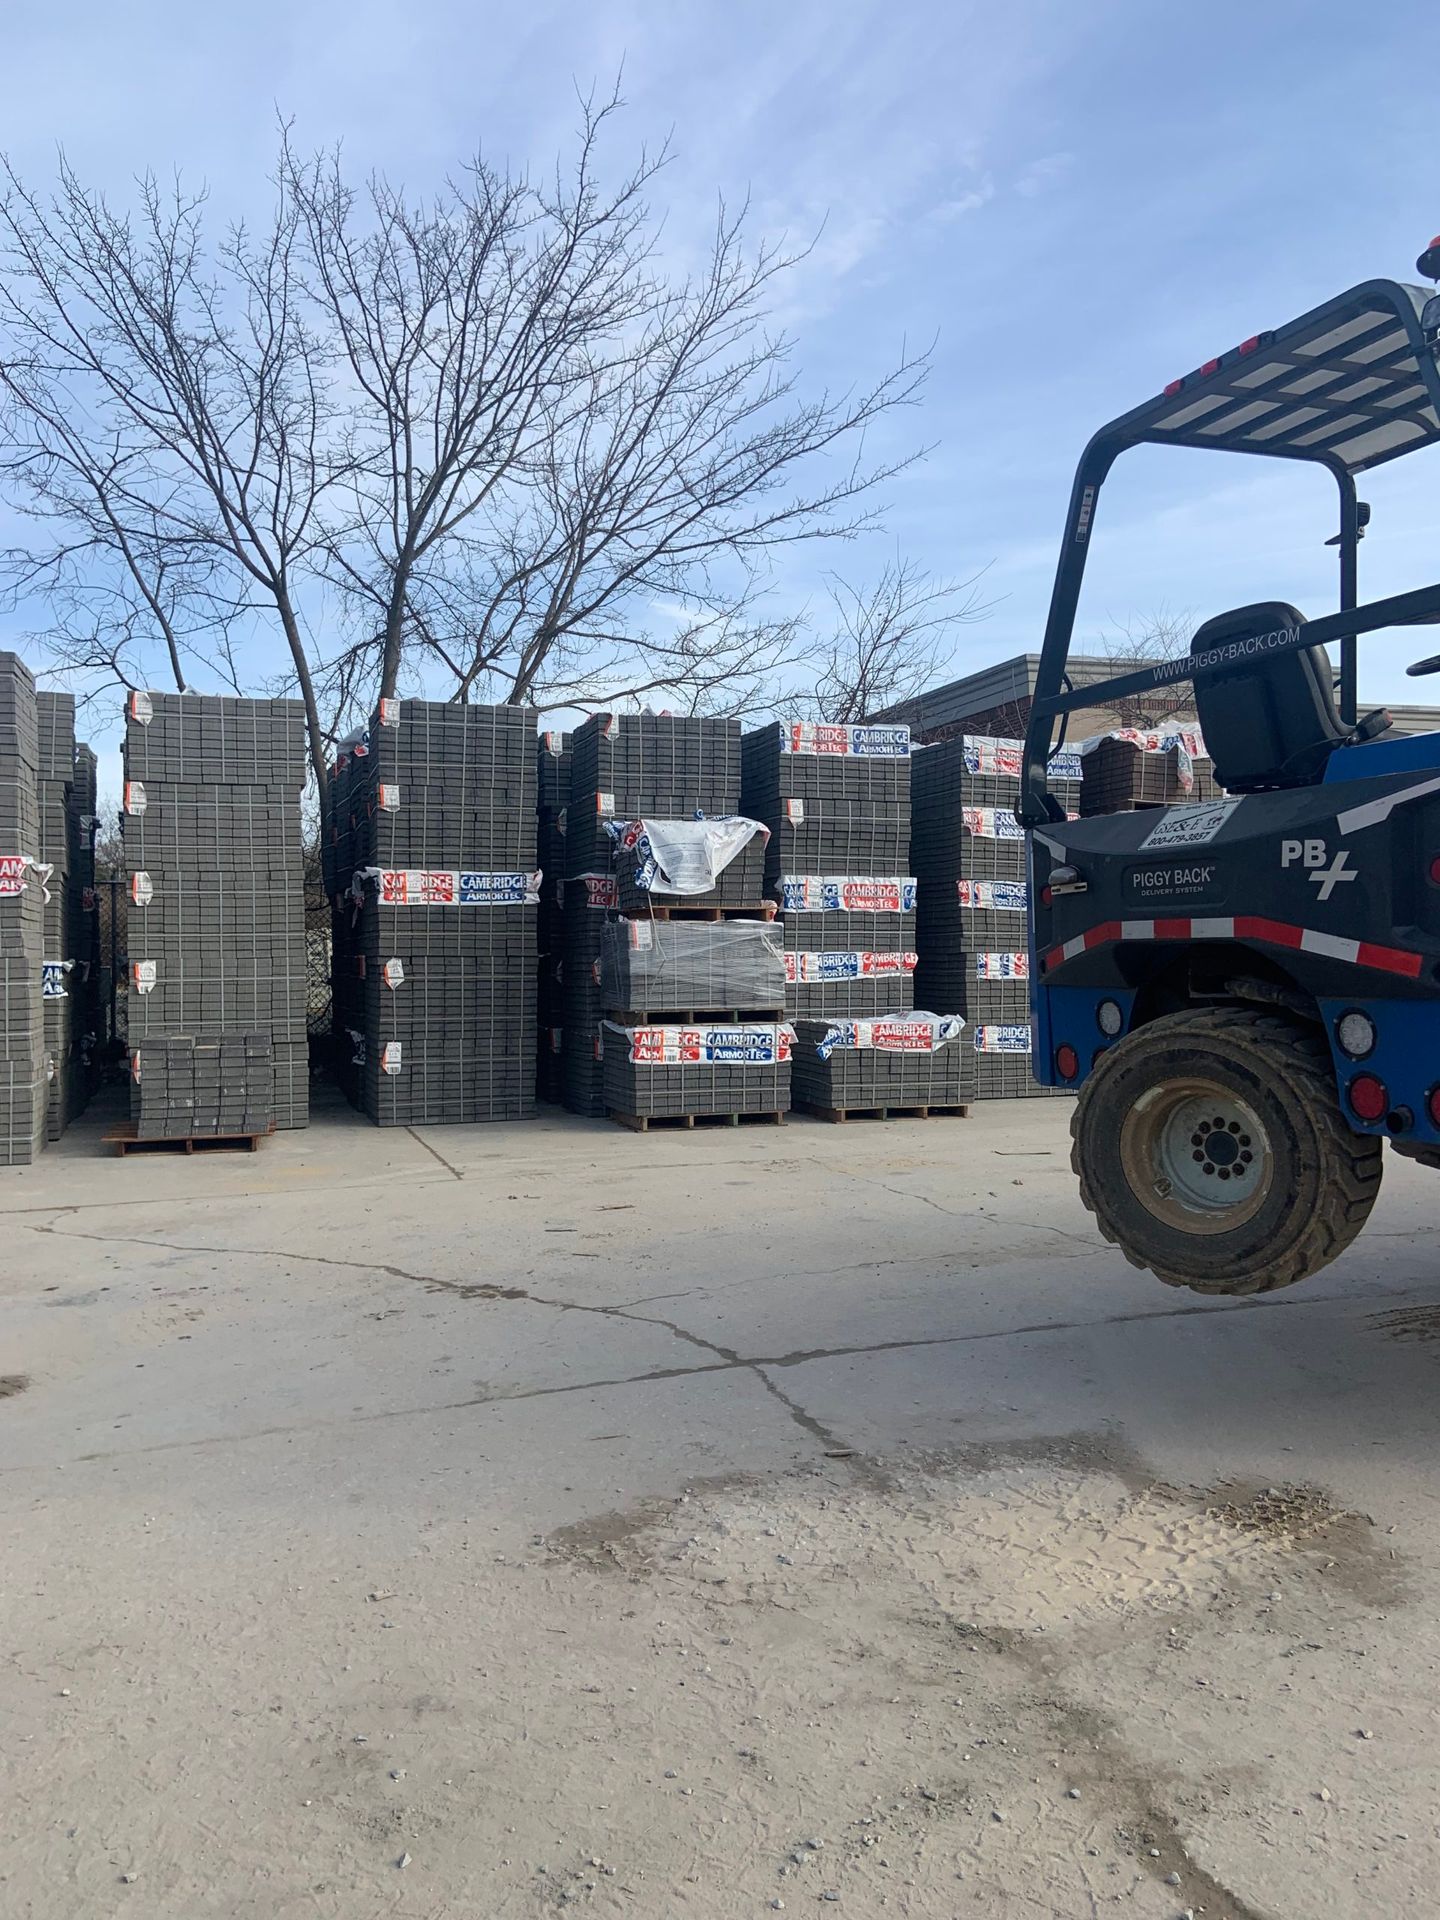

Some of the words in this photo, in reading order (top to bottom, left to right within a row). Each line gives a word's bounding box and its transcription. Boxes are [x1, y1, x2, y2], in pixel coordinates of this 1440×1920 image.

[1153, 626, 1300, 681] WWW.PIGGY-BACK.COM
[1133, 870, 1171, 887] PIGGY
[1174, 866, 1211, 884] BACK
[1142, 888, 1173, 896] DELIVERY
[1175, 886, 1203, 894] SYSTEM
